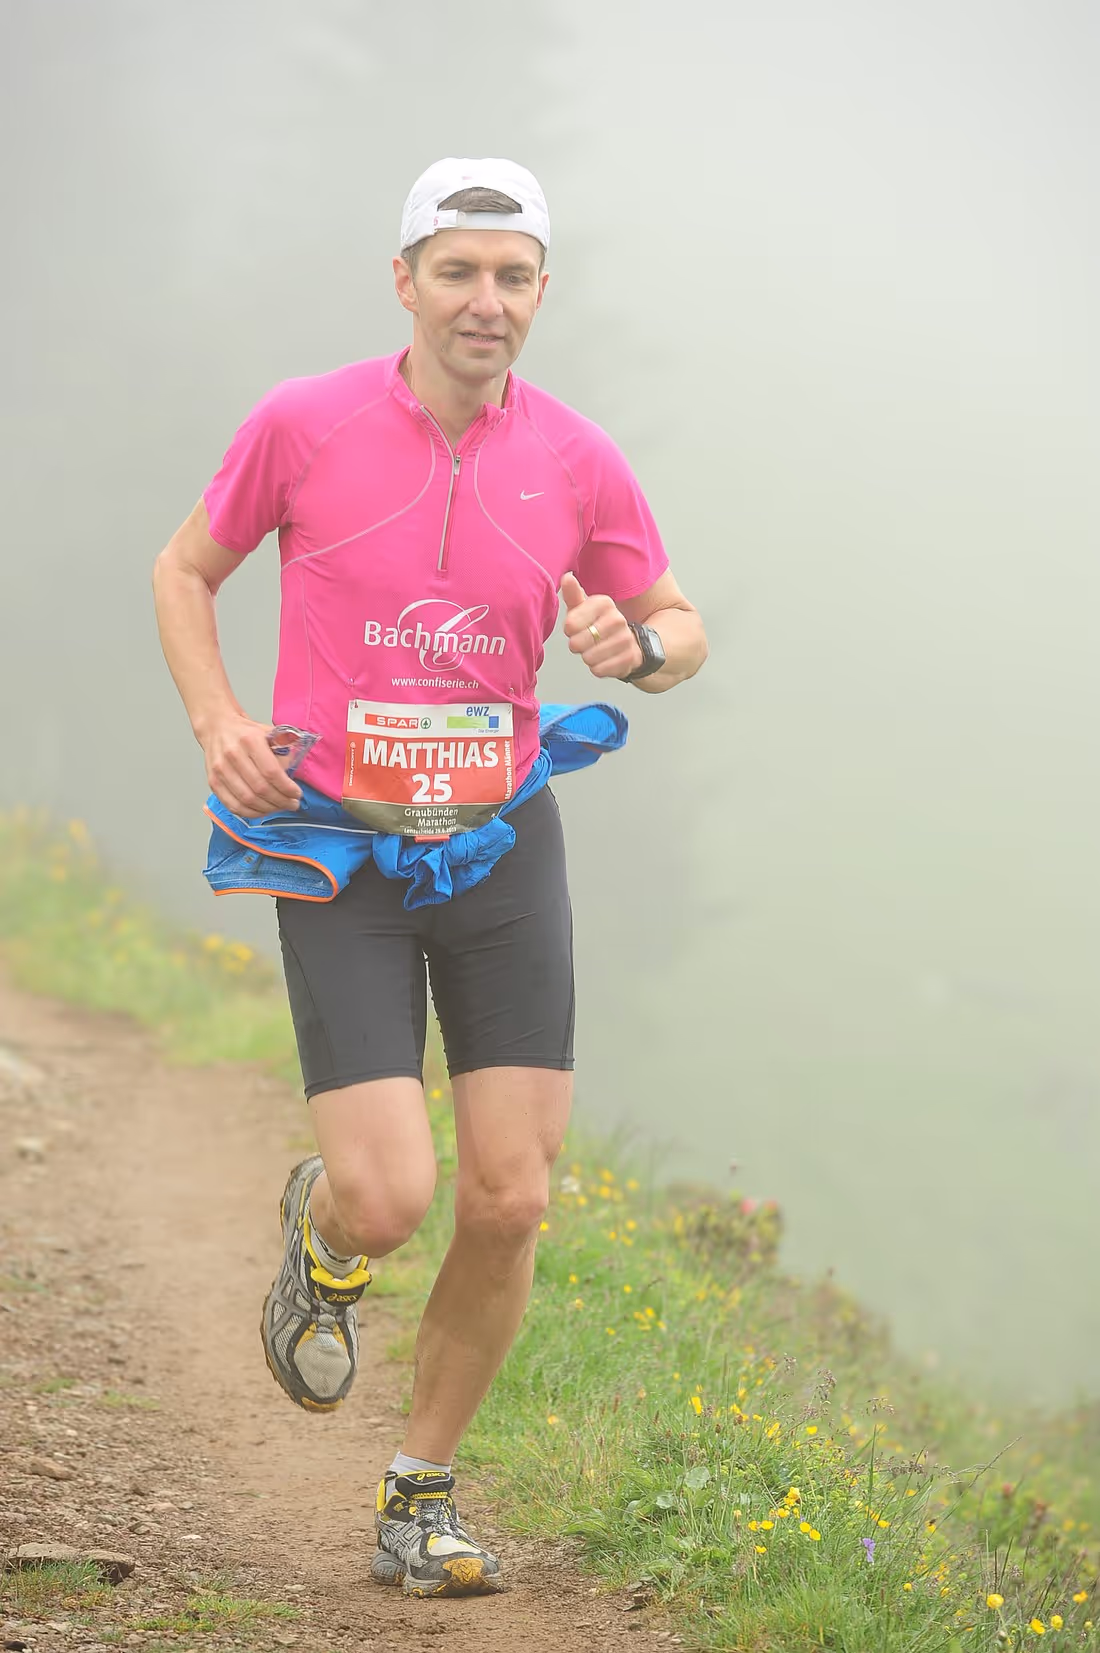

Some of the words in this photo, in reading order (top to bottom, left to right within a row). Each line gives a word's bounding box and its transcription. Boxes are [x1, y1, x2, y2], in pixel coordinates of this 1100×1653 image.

[363, 620, 506, 655] Bachmann
[391, 676, 479, 689] www.confiserie.ch
[466, 705, 490, 717] ewz
[376, 716, 419, 729] SPAR
[362, 738, 499, 769] MATTHIAS
[503, 740, 511, 767] Männer
[411, 773, 453, 803] 25
[504, 767, 513, 800] Marathon
[404, 807, 458, 817] Graubünden
[417, 817, 456, 827] Marathon
